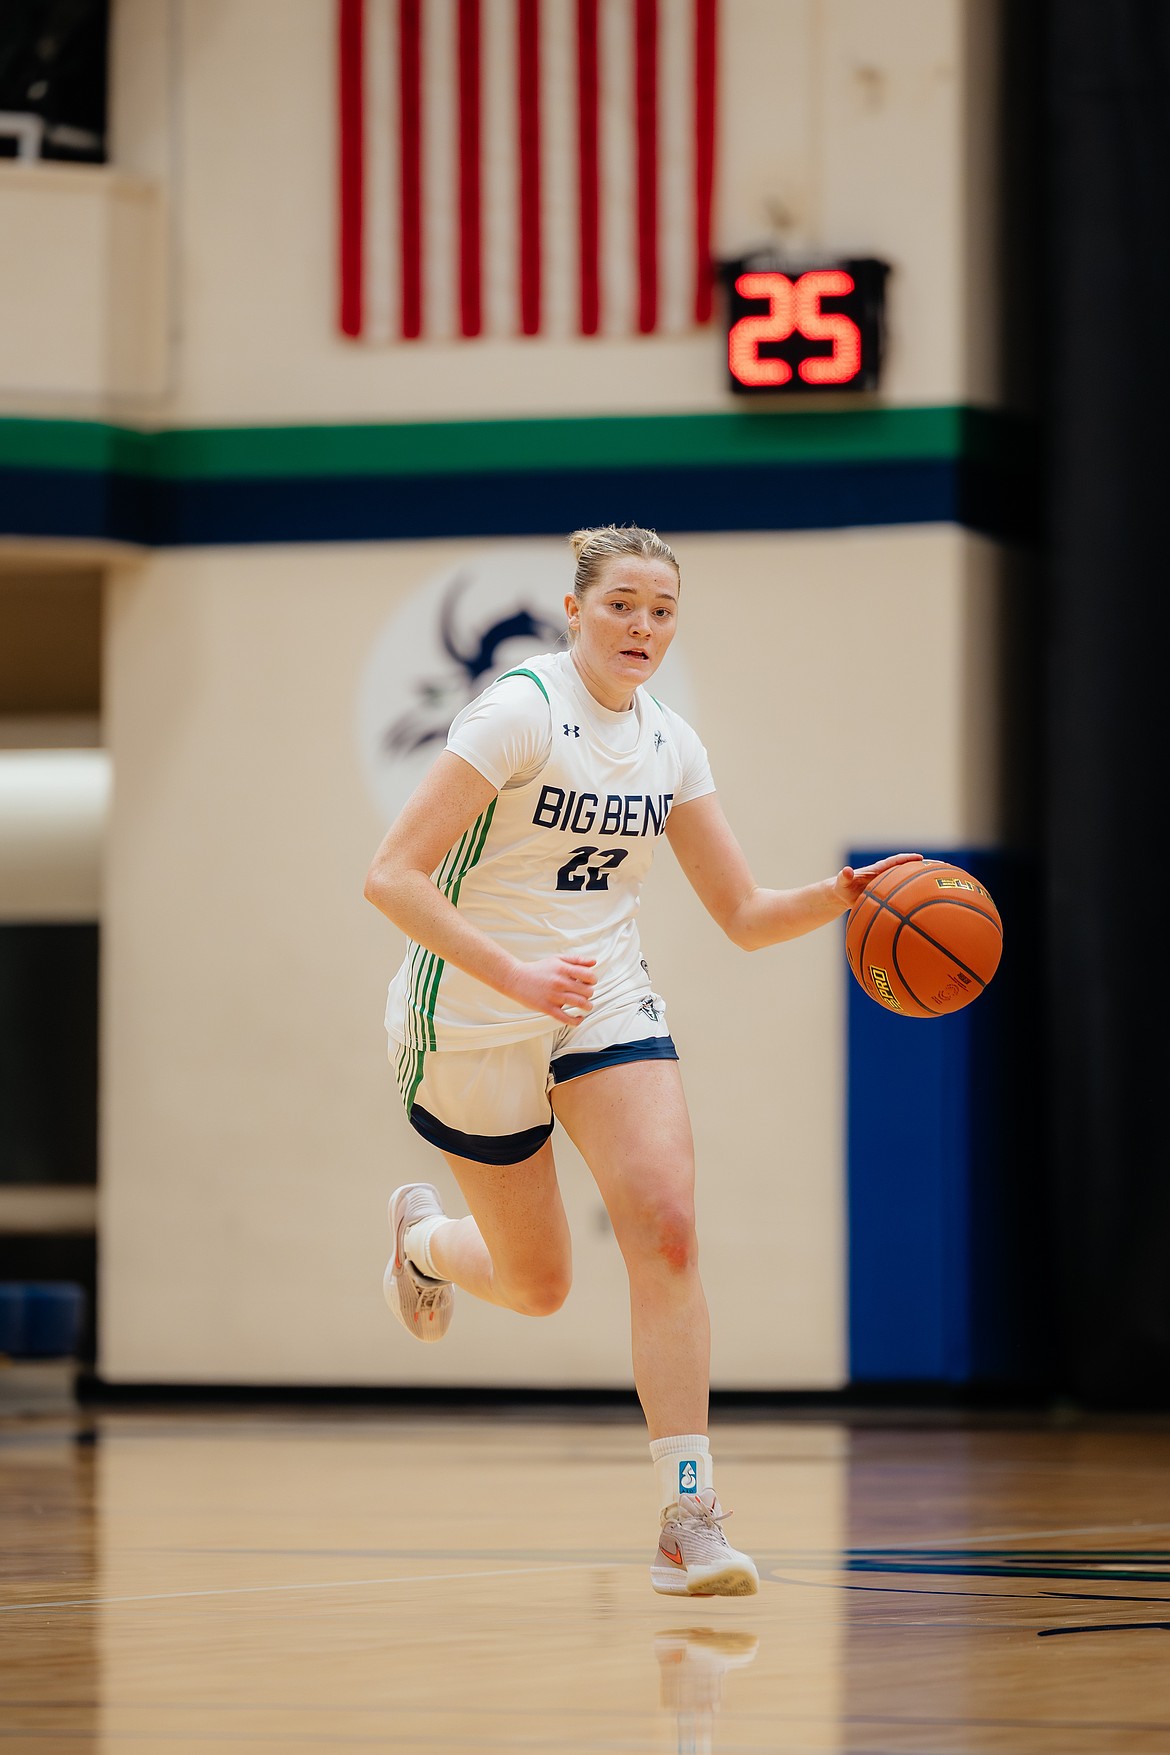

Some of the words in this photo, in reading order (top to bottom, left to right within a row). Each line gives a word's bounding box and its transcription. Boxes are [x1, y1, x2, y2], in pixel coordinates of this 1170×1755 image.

[728, 270, 861, 386] 25
[532, 785, 599, 834] BIG
[556, 846, 629, 891] 22
[872, 968, 894, 999] PRO
